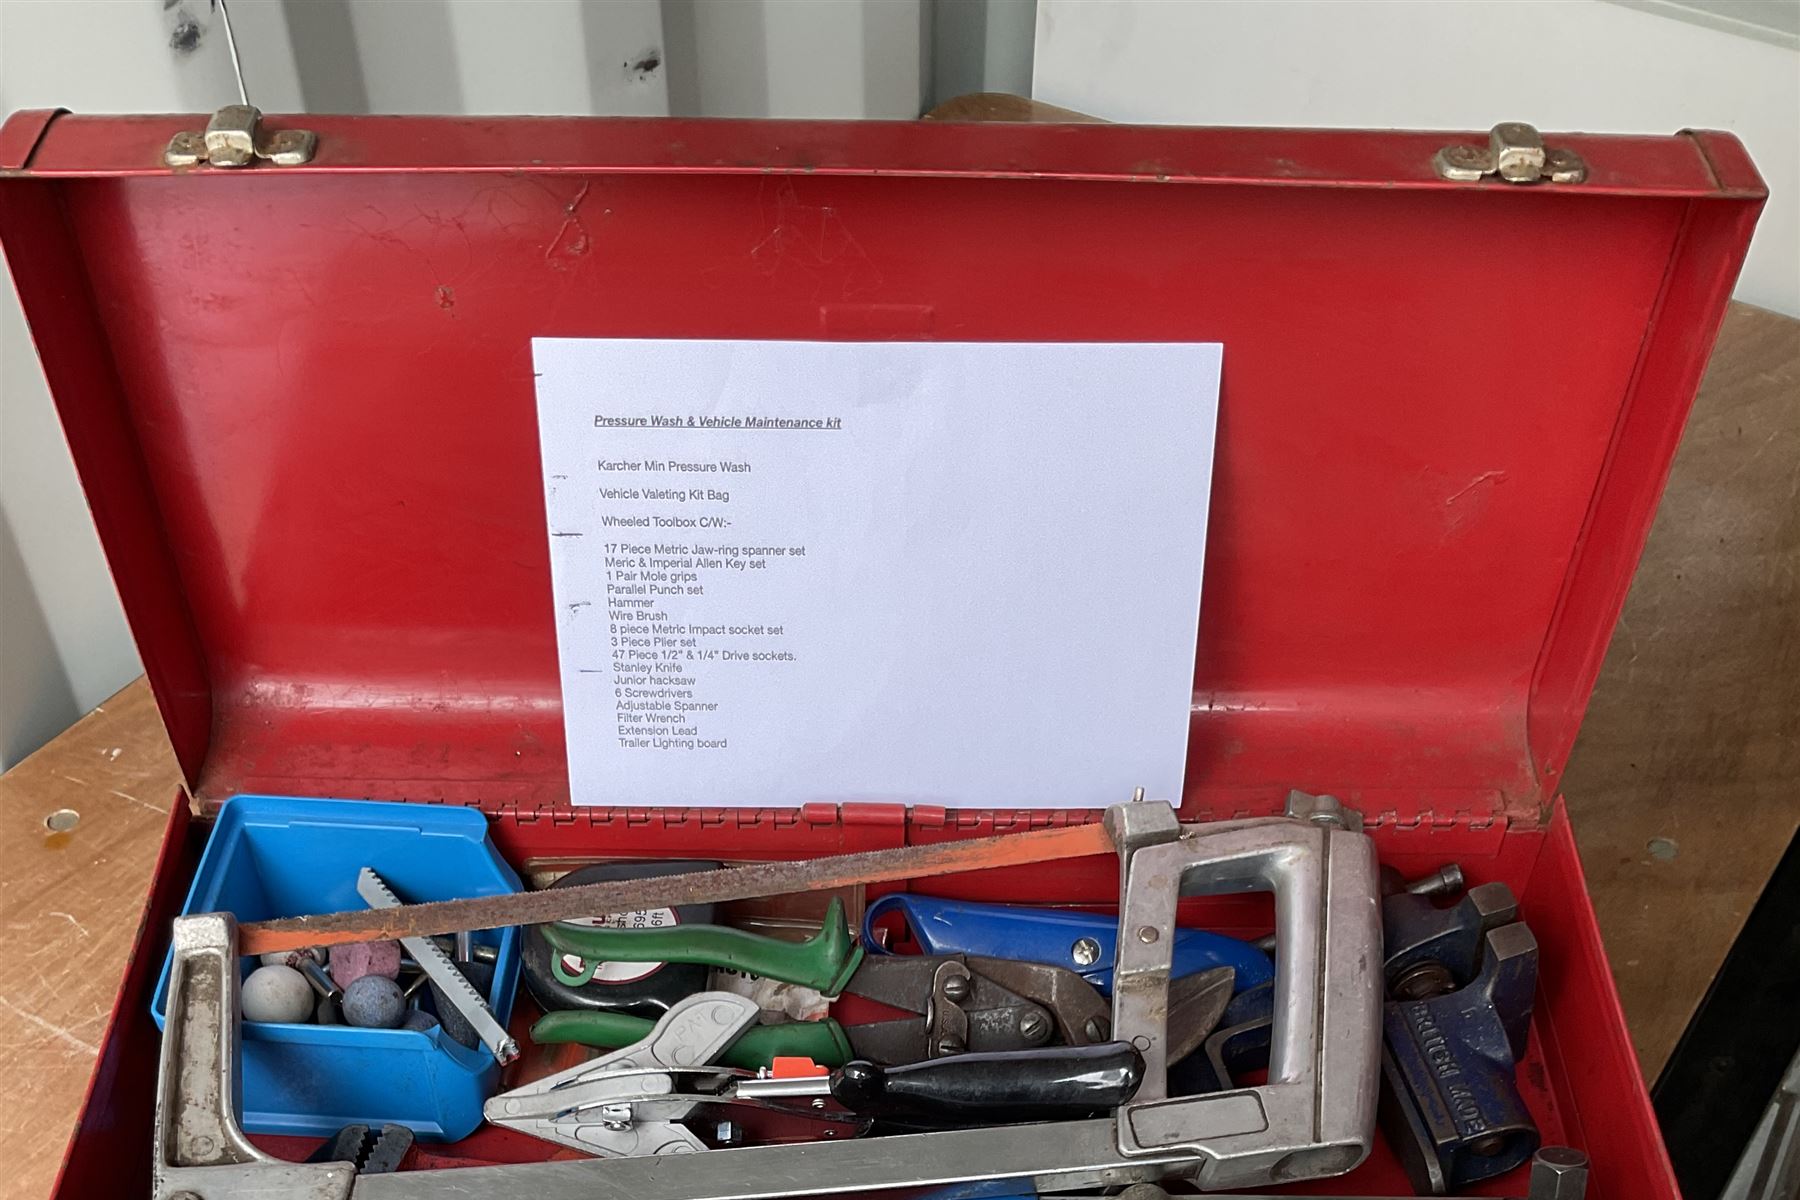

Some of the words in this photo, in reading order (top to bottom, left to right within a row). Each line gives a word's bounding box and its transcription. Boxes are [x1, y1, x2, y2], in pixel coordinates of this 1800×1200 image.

[594, 415, 648, 427] Pressure
[649, 415, 684, 428] Wash
[686, 416, 696, 428] &
[698, 416, 743, 429] Vehicle
[743, 416, 824, 429] Maintenance
[825, 417, 842, 430] kit
[598, 460, 641, 471] Karcher
[644, 460, 665, 471] Min
[668, 461, 717, 472] Pressure
[720, 461, 751, 472] Wash
[599, 488, 639, 499] Vehicle
[642, 488, 685, 502] Valeting
[689, 489, 704, 500] Kit
[707, 490, 729, 503] Bag
[602, 514, 650, 527] Wheeled
[652, 516, 696, 527] Toolbox
[699, 517, 732, 528] C/W:-
[604, 543, 617, 553] 17
[621, 544, 651, 554] Piece
[654, 544, 688, 554] Metric
[690, 544, 739, 559] Jaw-ring
[742, 547, 786, 558] spanner
[789, 546, 805, 556] set
[605, 557, 635, 567] Meric
[639, 557, 647, 568] &
[650, 557, 692, 570] Imperial
[696, 558, 722, 568] Allen
[726, 558, 746, 571] Key
[749, 559, 766, 569] set
[606, 571, 611, 580] 1
[616, 571, 637, 581] Pair
[640, 571, 667, 581] Mole
[670, 571, 697, 583] grips
[607, 584, 646, 594] Parallel
[650, 584, 684, 594] Punch
[687, 585, 703, 595] set
[608, 597, 654, 608] Hammer
[608, 610, 633, 621] Wire
[636, 611, 667, 621] Brush
[610, 624, 617, 633] 8
[620, 624, 649, 636] piece
[652, 624, 685, 634] Metric
[689, 624, 726, 638] Impact
[729, 625, 764, 635] socket
[767, 626, 783, 635] set
[611, 637, 618, 646] 3
[621, 637, 650, 647] Piece
[654, 637, 677, 647] Plier
[680, 637, 696, 647] set
[612, 649, 625, 659] 47
[629, 650, 658, 660] Piece
[662, 650, 683, 659] 1/2"
[686, 650, 694, 660] &
[698, 650, 719, 660] 1/4"
[722, 650, 749, 660] Drive
[752, 651, 796, 661] sockets.
[613, 662, 652, 676] Stanley
[655, 663, 682, 672] Knife
[614, 675, 646, 685] Junior
[650, 675, 696, 685] hacksaw
[615, 688, 622, 697] 6
[625, 688, 693, 698] Screwdrivers
[616, 700, 671, 714] Adjustable
[674, 701, 718, 713] Spanner
[617, 713, 643, 722] Filter
[645, 712, 685, 723] Wrench
[618, 725, 668, 735] Extension
[672, 726, 697, 735] Lead
[618, 738, 650, 747] Trailer
[653, 738, 694, 750] Lighting
[697, 738, 727, 748] board
